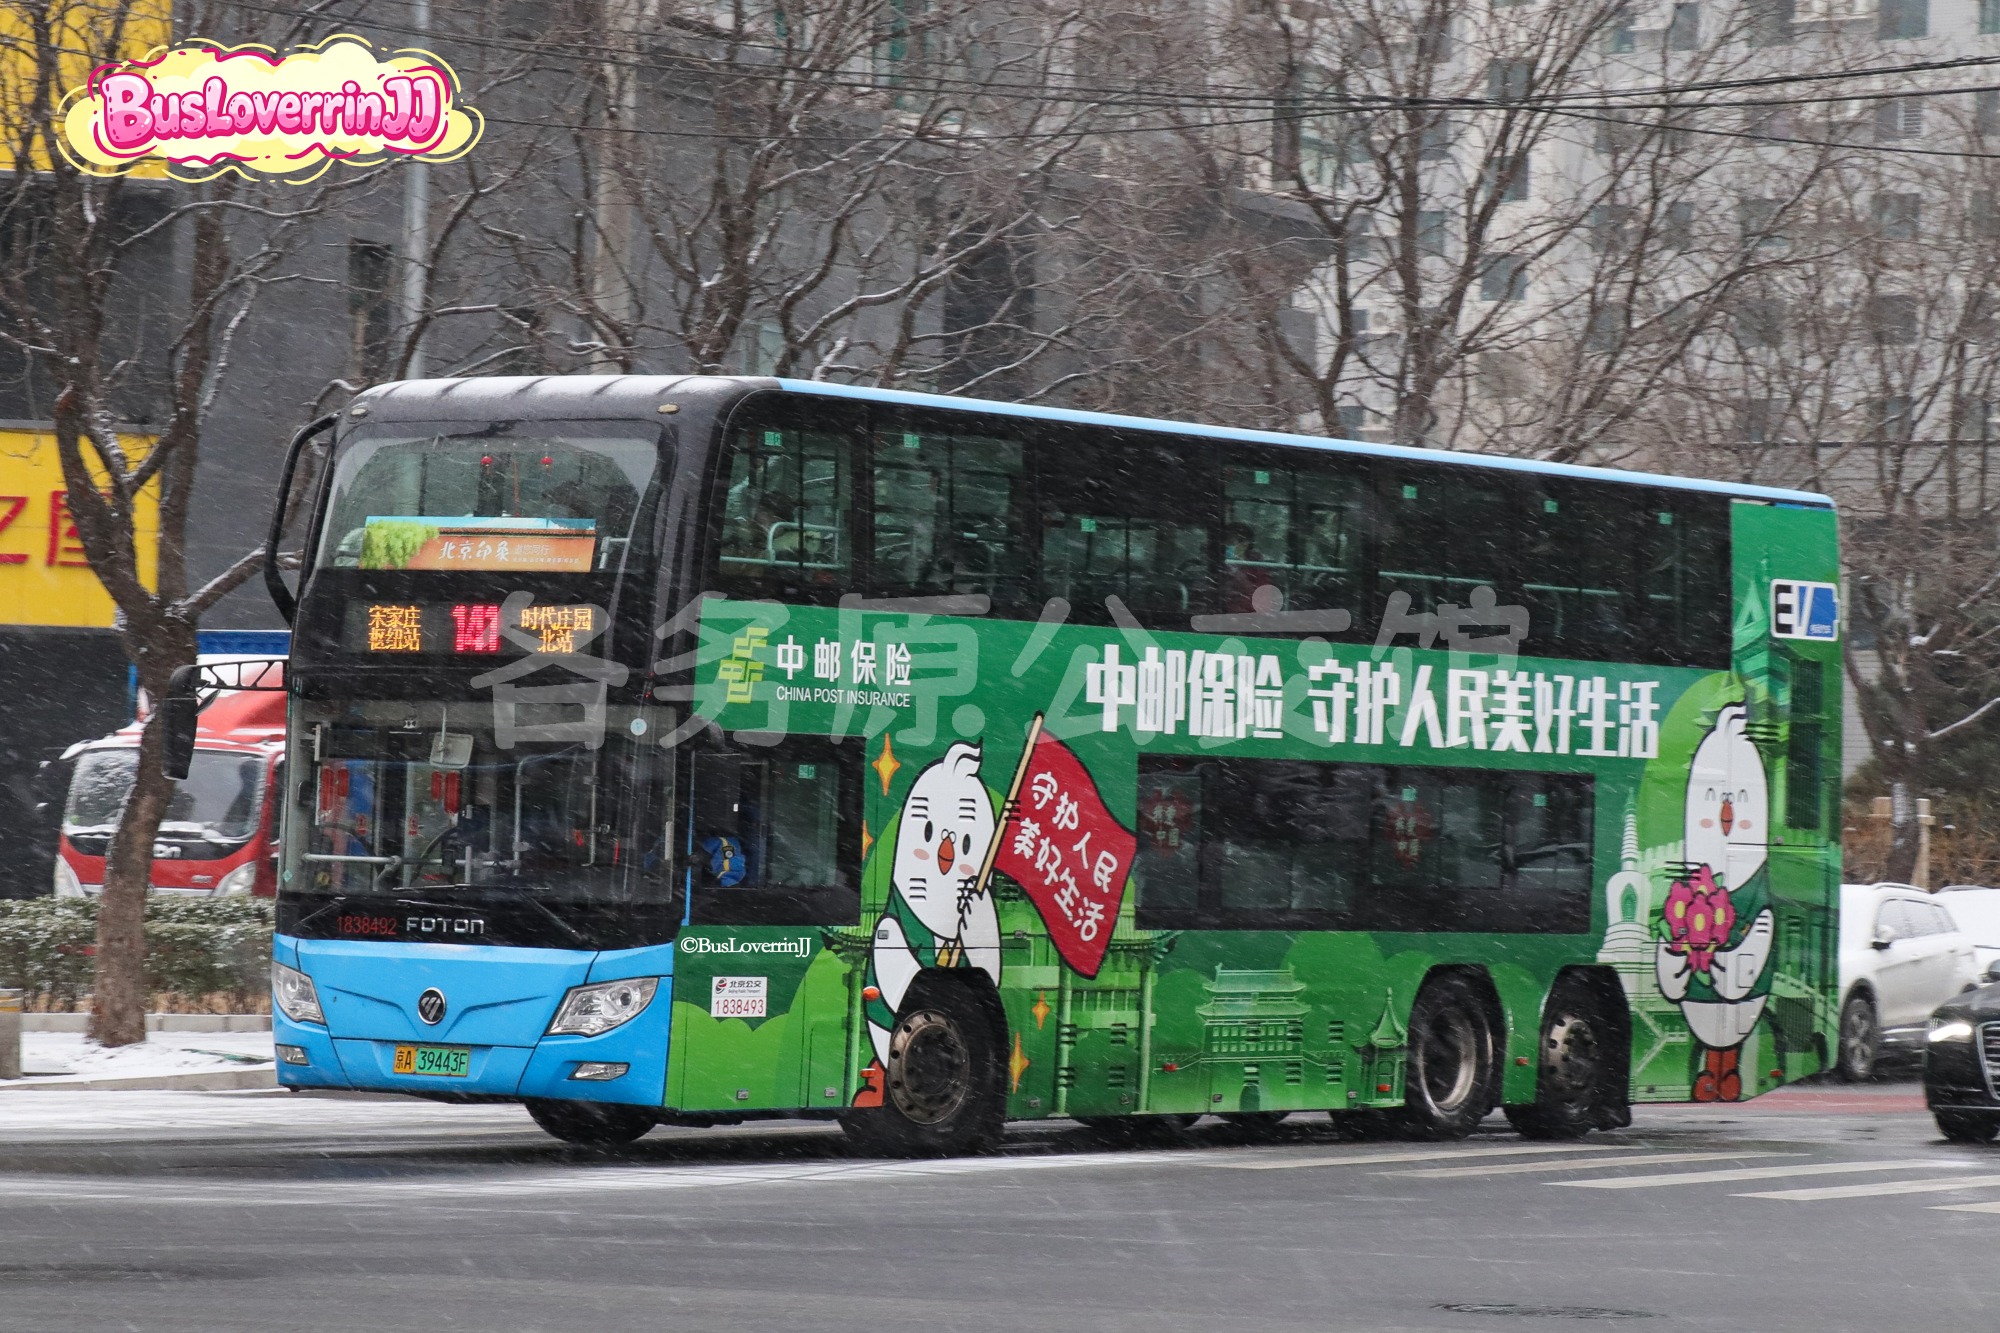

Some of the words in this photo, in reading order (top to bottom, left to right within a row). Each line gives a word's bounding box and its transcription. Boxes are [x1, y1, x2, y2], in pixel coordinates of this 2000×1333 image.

[368, 605, 421, 628] 宋家庄
[521, 607, 593, 630] 时代庄园
[368, 628, 421, 651] 枢纽站
[537, 629, 574, 653] 北站
[776, 634, 912, 686] 中邮保险
[776, 685, 812, 702] CHINA
[814, 688, 844, 704] POST
[847, 689, 911, 708] INSURANCE
[1086, 643, 1284, 740] 中邮保险
[1307, 658, 1660, 759] 守护人民美好生活
[1031, 771, 1118, 893] 守护人民
[1014, 817, 1104, 941] 美好生活
[336, 916, 398, 935] 1838492
[406, 917, 485, 934] FOTON
[729, 980, 761, 988] 北京公交
[715, 999, 764, 1014] 1838493
